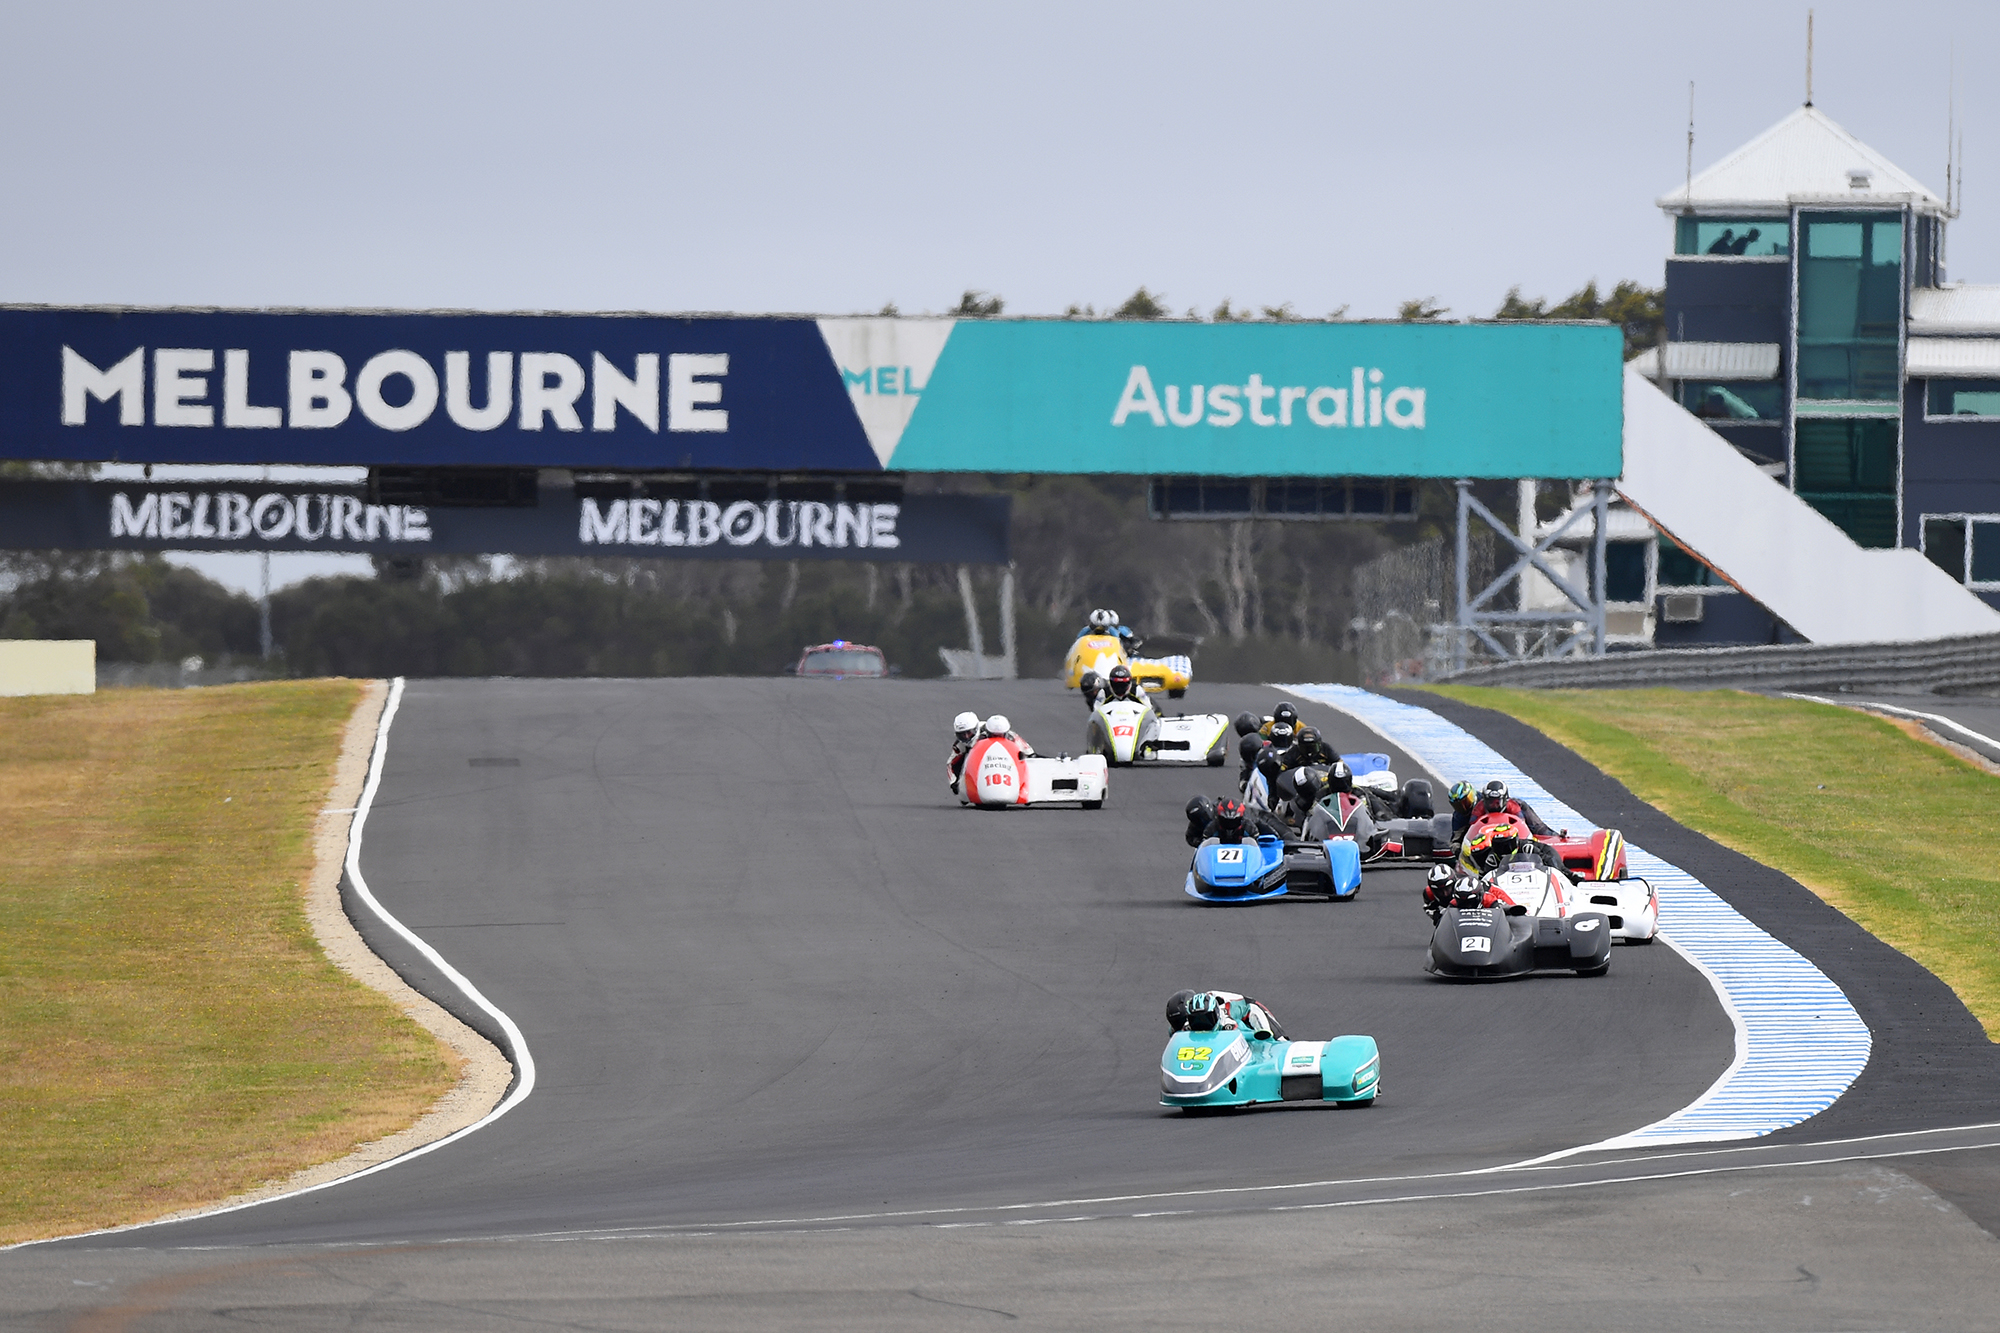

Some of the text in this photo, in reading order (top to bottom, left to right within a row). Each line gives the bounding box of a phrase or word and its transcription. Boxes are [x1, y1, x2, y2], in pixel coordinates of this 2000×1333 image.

[61, 345, 730, 434] MELBOURNE
[842, 366, 924, 395] MEL
[1111, 365, 1425, 428] Australia
[110, 492, 433, 542] MELBOURNE
[579, 498, 900, 548] MELBOURNE
[985, 773, 1012, 787] 103
[1221, 849, 1240, 861] 27
[1511, 874, 1532, 884] 51
[1466, 938, 1485, 949] 21
[1177, 1046, 1213, 1061] 52
